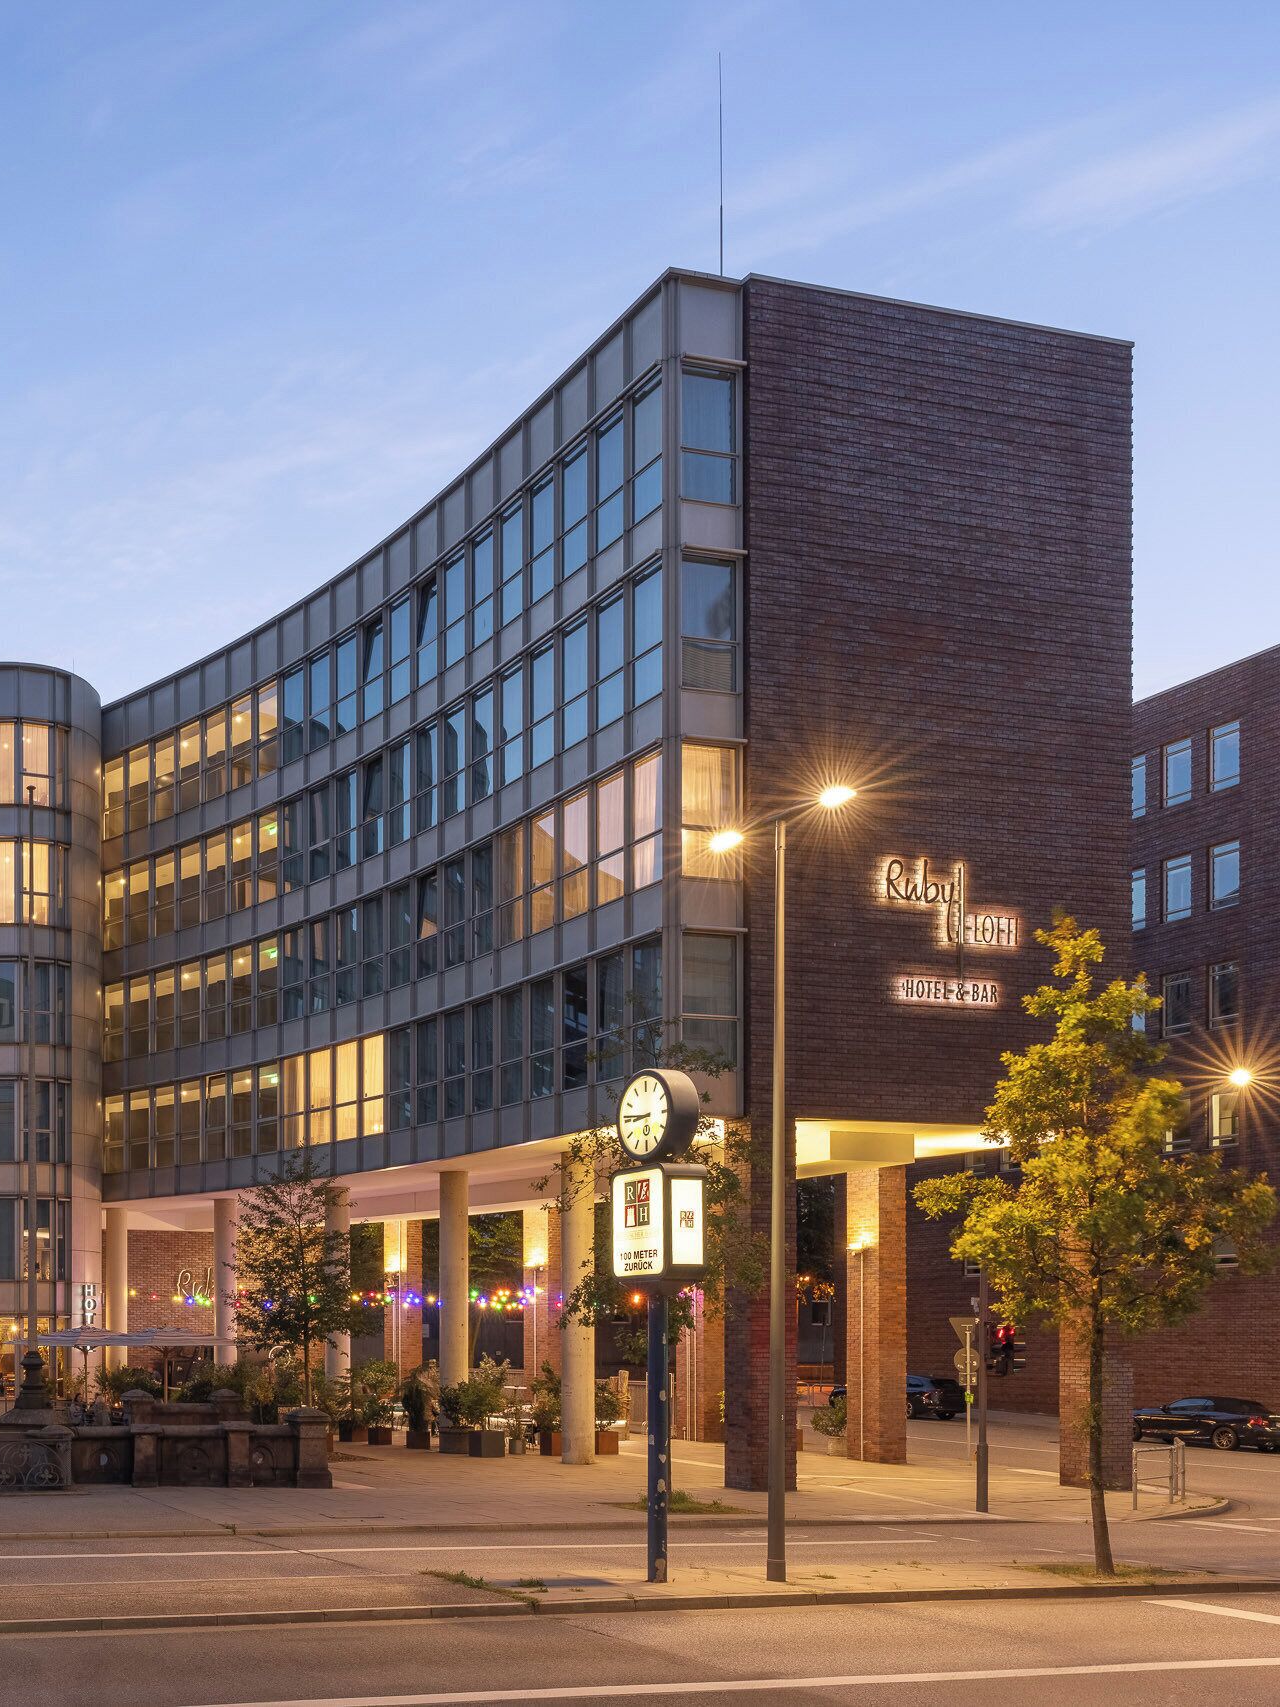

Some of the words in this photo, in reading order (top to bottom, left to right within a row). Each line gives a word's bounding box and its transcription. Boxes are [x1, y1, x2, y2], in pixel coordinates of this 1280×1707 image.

[886, 859, 955, 942] Ruby
[974, 914, 1019, 945] LOTTI
[905, 979, 950, 1000] HOTEL
[955, 982, 965, 1001] &
[971, 983, 998, 1003] BAR
[620, 1251, 632, 1260] 100
[633, 1249, 658, 1260] METER
[624, 1260, 653, 1271] ZURÜCK
